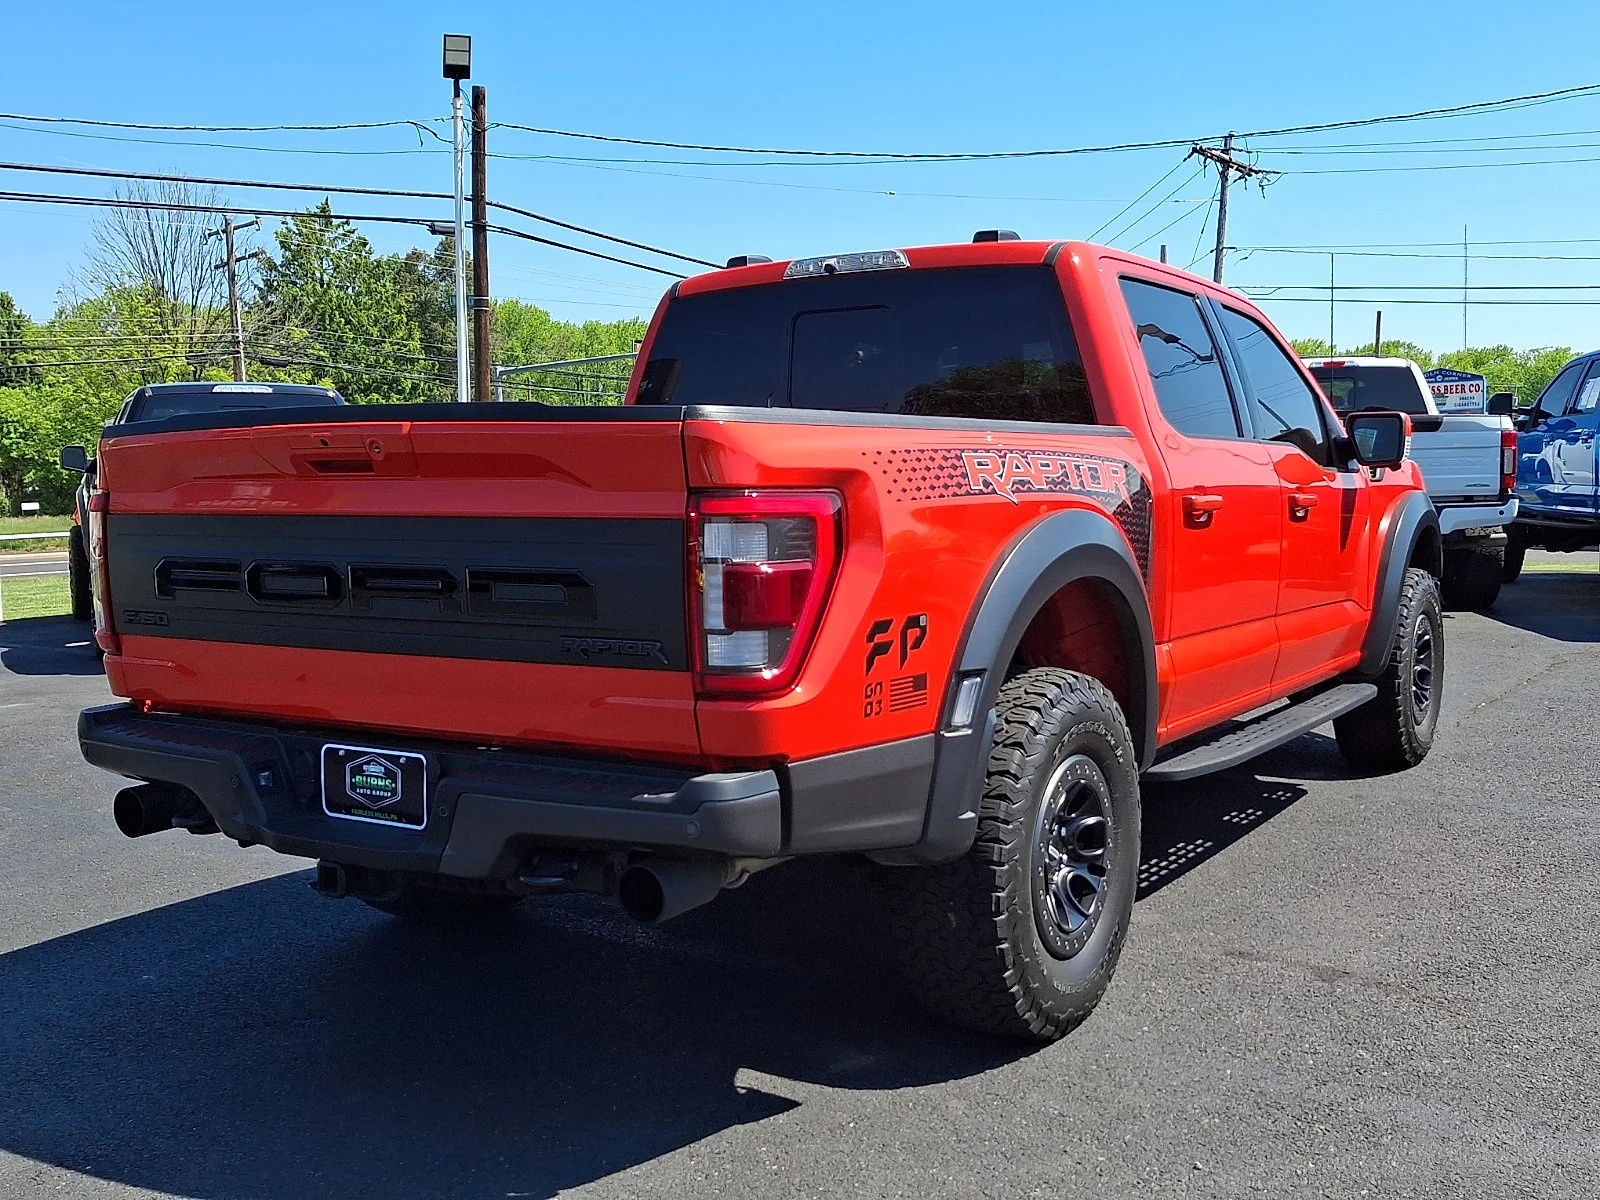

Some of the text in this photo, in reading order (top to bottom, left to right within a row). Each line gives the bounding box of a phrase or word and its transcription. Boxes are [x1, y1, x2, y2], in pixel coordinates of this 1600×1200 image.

[1441, 370, 1472, 379] CORNER
[1429, 383, 1483, 395] SS BEER CO.
[962, 452, 1133, 507] RAPTOR
[153, 555, 597, 620] FORD
[559, 633, 669, 665] RAPTOR
[355, 774, 393, 790] BURNS
[356, 787, 392, 797] AUTO GROUP
[351, 808, 374, 817] FAIRLESS
